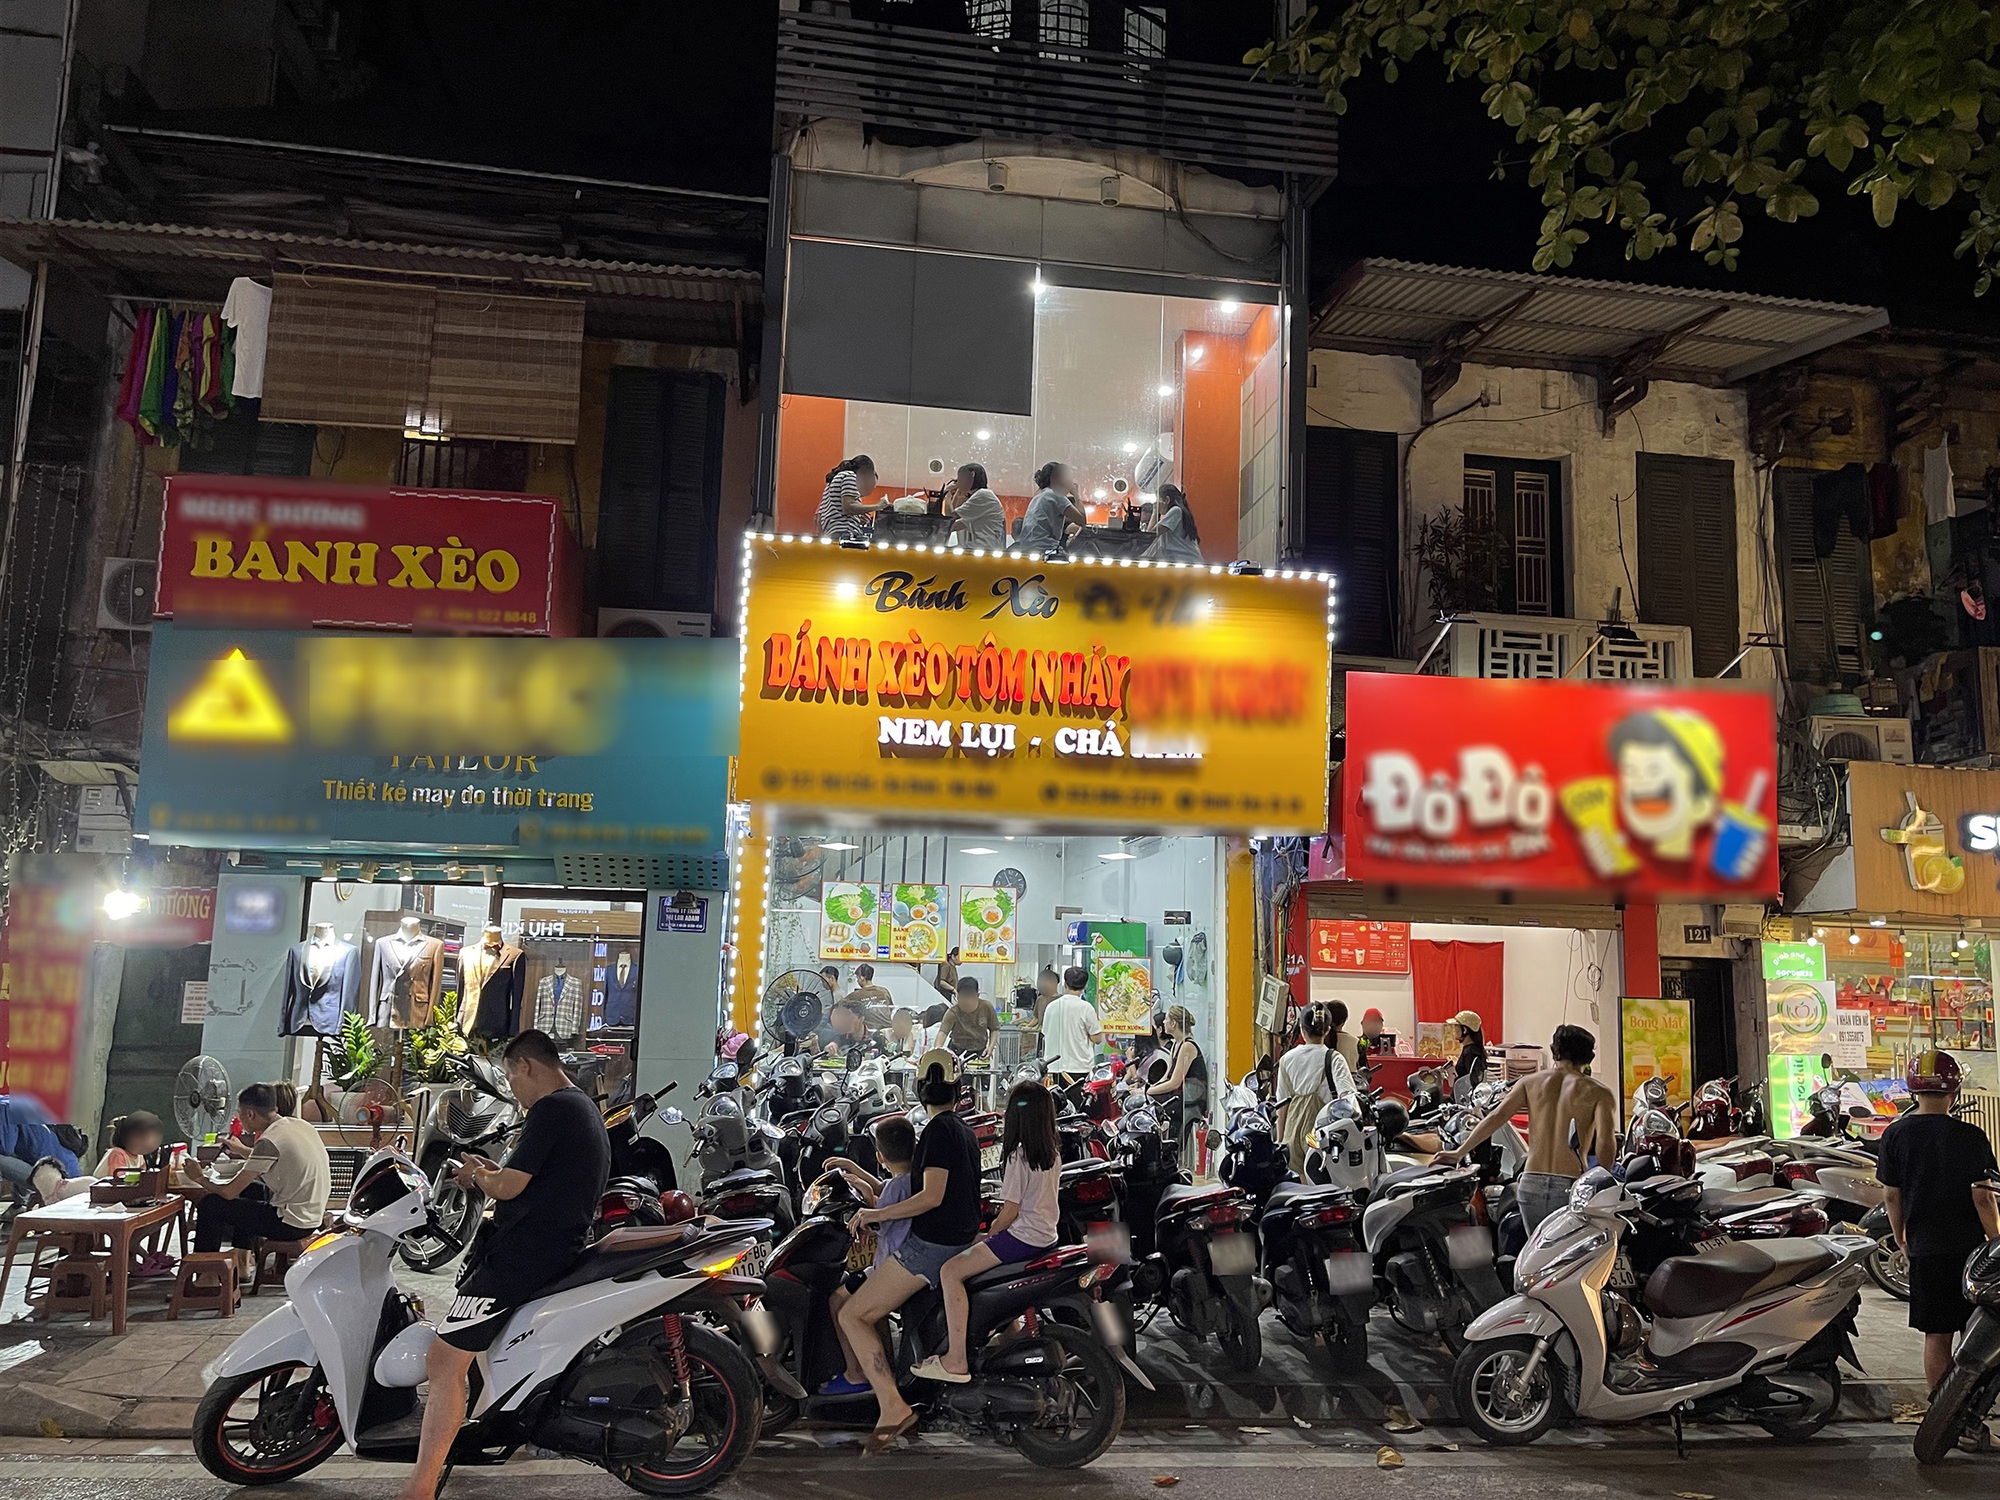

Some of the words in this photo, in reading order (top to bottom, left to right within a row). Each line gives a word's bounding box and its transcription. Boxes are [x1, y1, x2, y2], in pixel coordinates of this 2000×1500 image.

[190, 525, 380, 586] BÁNH
[387, 535, 520, 593] XÈO
[864, 570, 970, 614] Bánh
[980, 573, 1061, 620] Xèo
[768, 619, 871, 692] BÁNH
[877, 629, 950, 698] XÈO
[956, 630, 1029, 704] TÔM
[1031, 637, 1131, 709] NHẢY
[877, 716, 952, 748] NEM
[958, 721, 1017, 757] LỤI
[1054, 720, 1125, 758] CHẢ
[323, 778, 377, 801] Thiết
[412, 786, 456, 809] may
[461, 784, 486, 806] đo
[492, 785, 532, 807] thời
[538, 787, 595, 812] trang
[1969, 815, 2000, 850] S
[1688, 928, 1709, 941] 121
[1629, 1015, 1659, 1031] Bóng
[1662, 1012, 1685, 1029] Mát
[448, 1295, 497, 1319] NIKE
